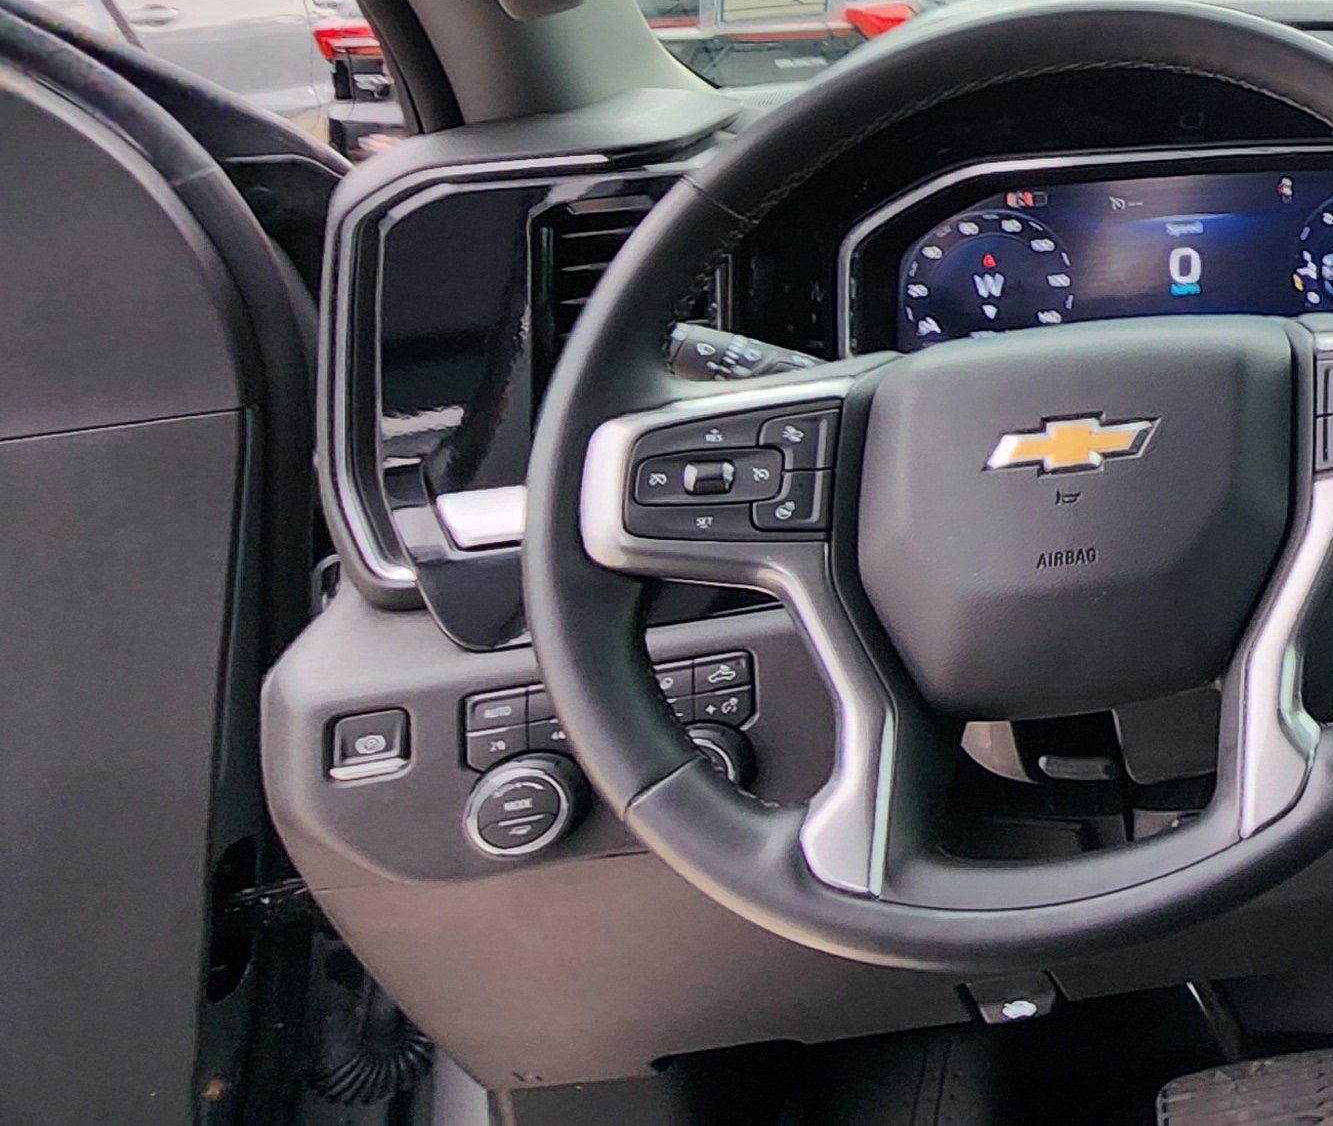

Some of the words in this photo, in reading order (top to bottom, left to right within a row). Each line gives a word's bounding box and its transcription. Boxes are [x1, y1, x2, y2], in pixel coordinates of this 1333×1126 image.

[1169, 247, 1202, 285] 0
[973, 272, 1005, 298] W
[1036, 547, 1097, 569] AIRBAG
